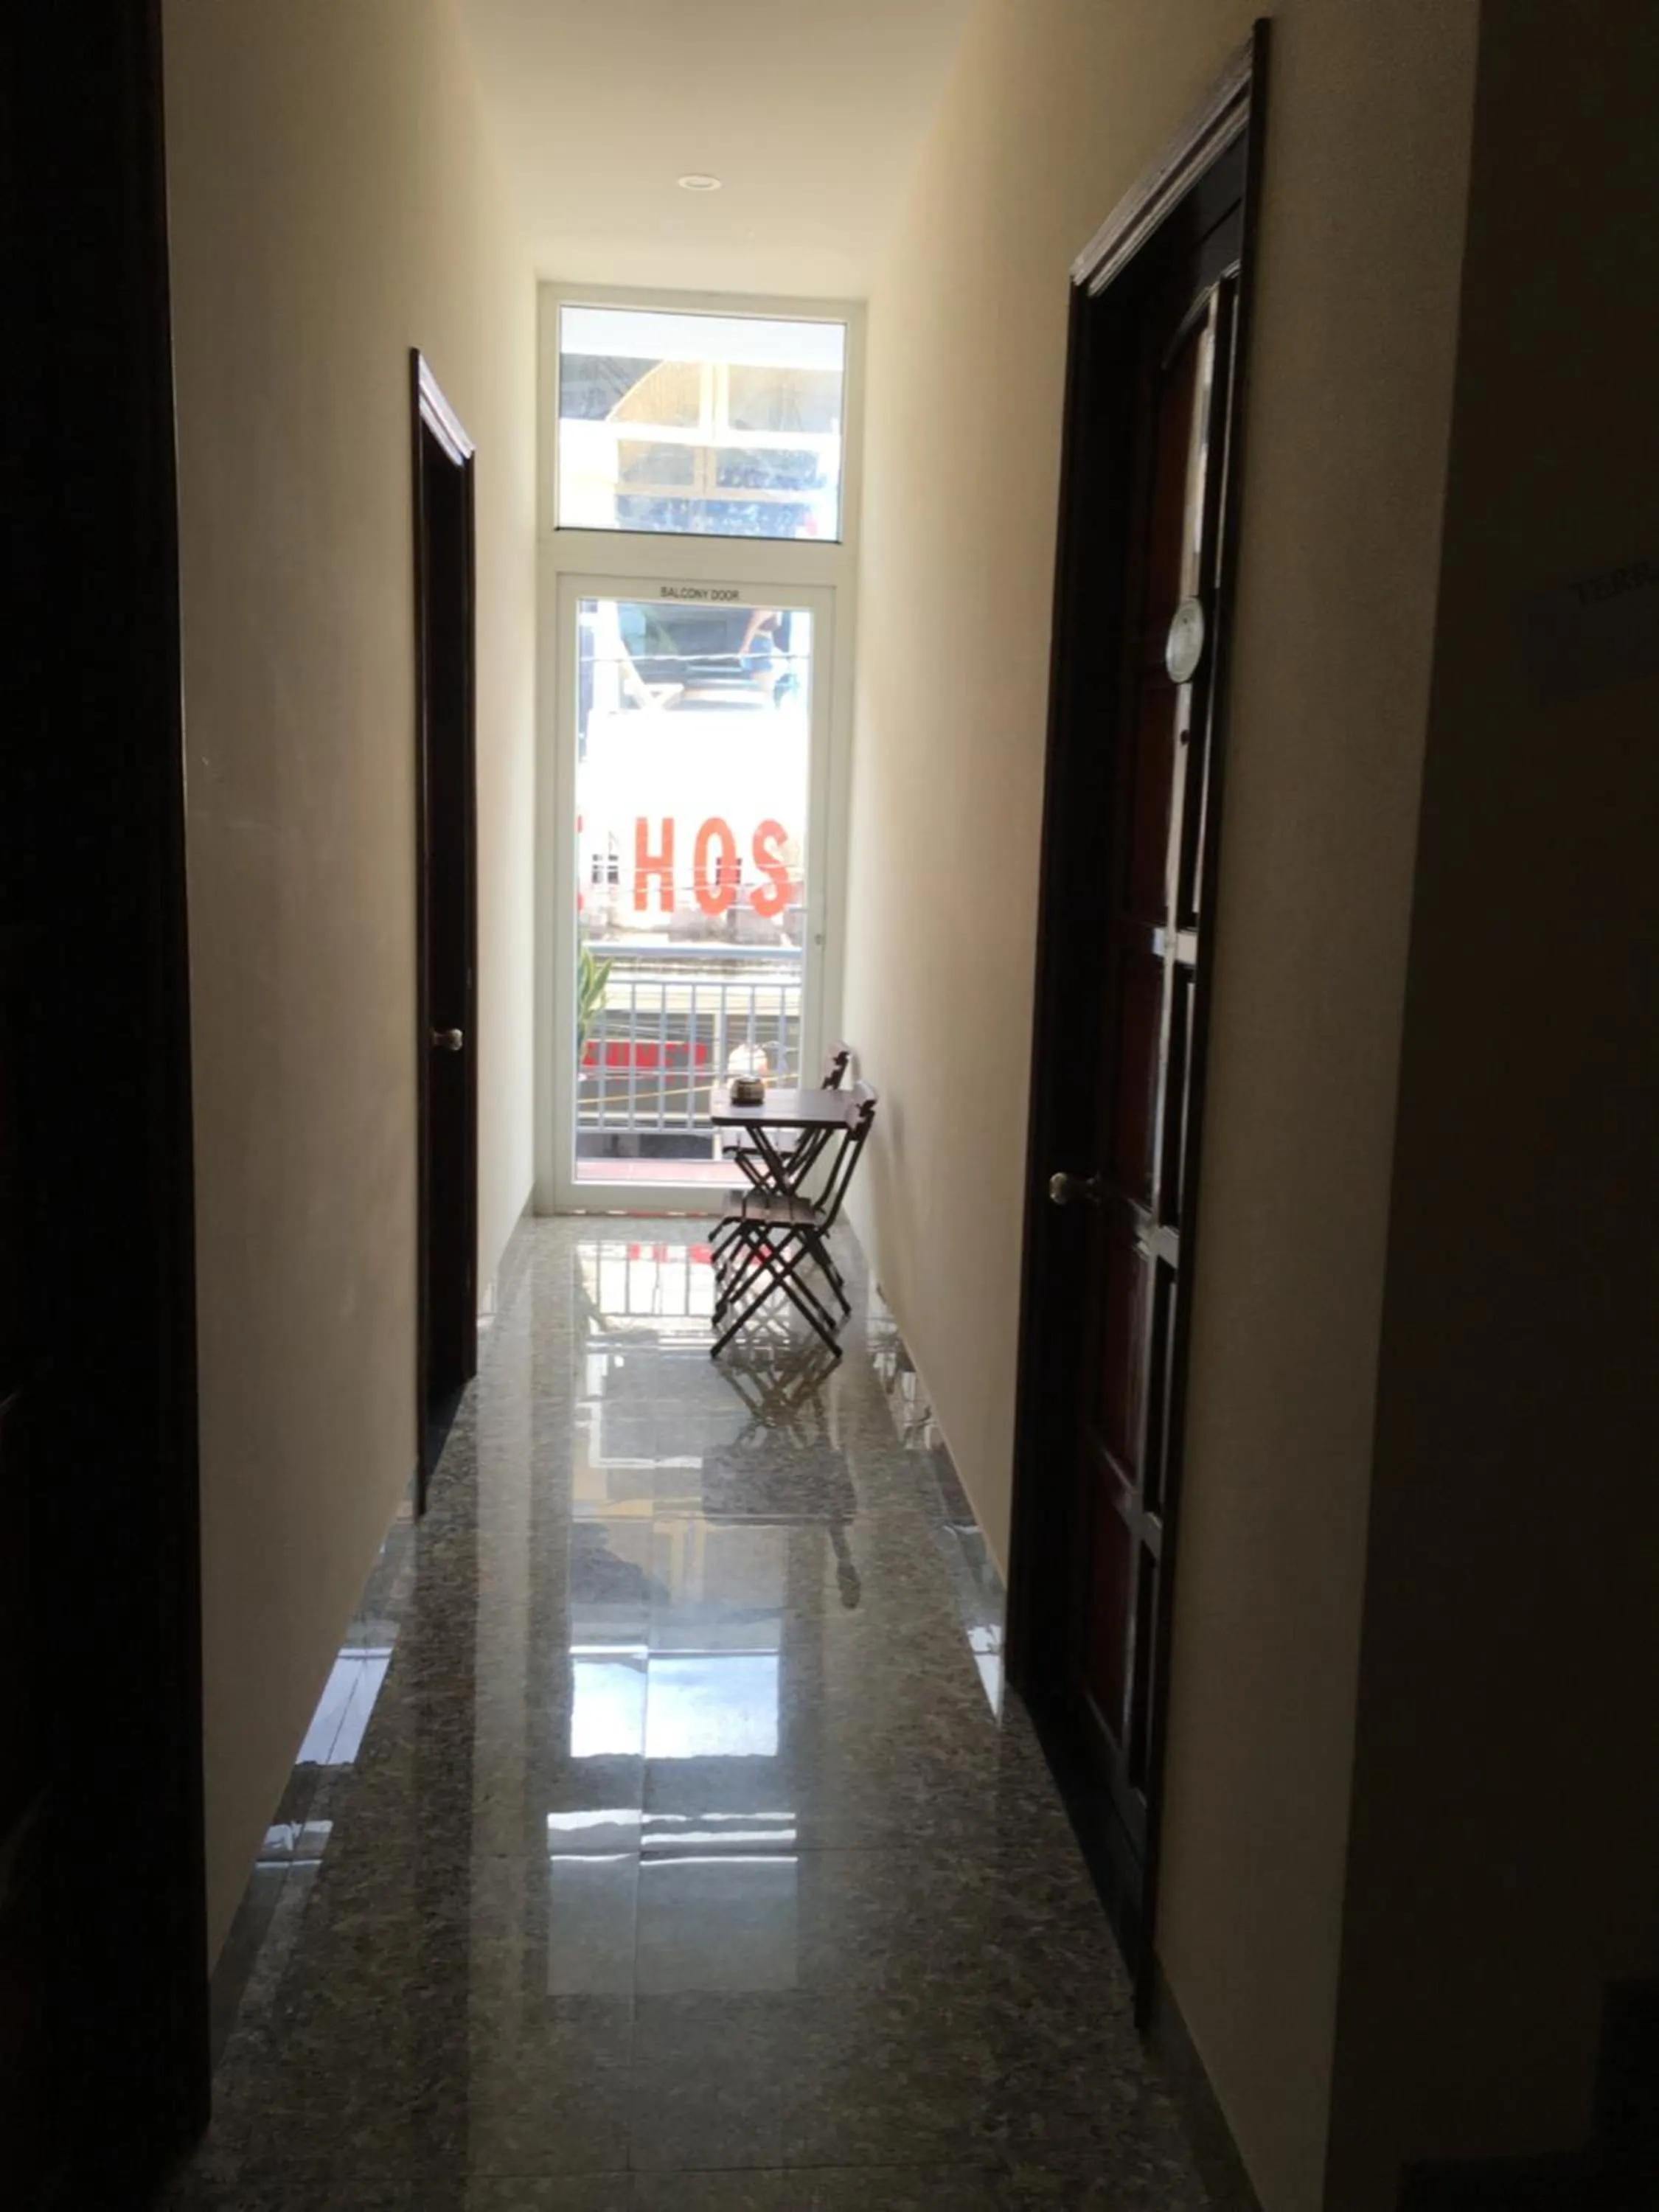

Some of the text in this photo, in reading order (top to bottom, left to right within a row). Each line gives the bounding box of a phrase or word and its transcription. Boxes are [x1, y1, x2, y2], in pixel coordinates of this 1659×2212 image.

[661, 586, 739, 601] BALCONY DOOR
[1568, 560, 1659, 605] TERR
